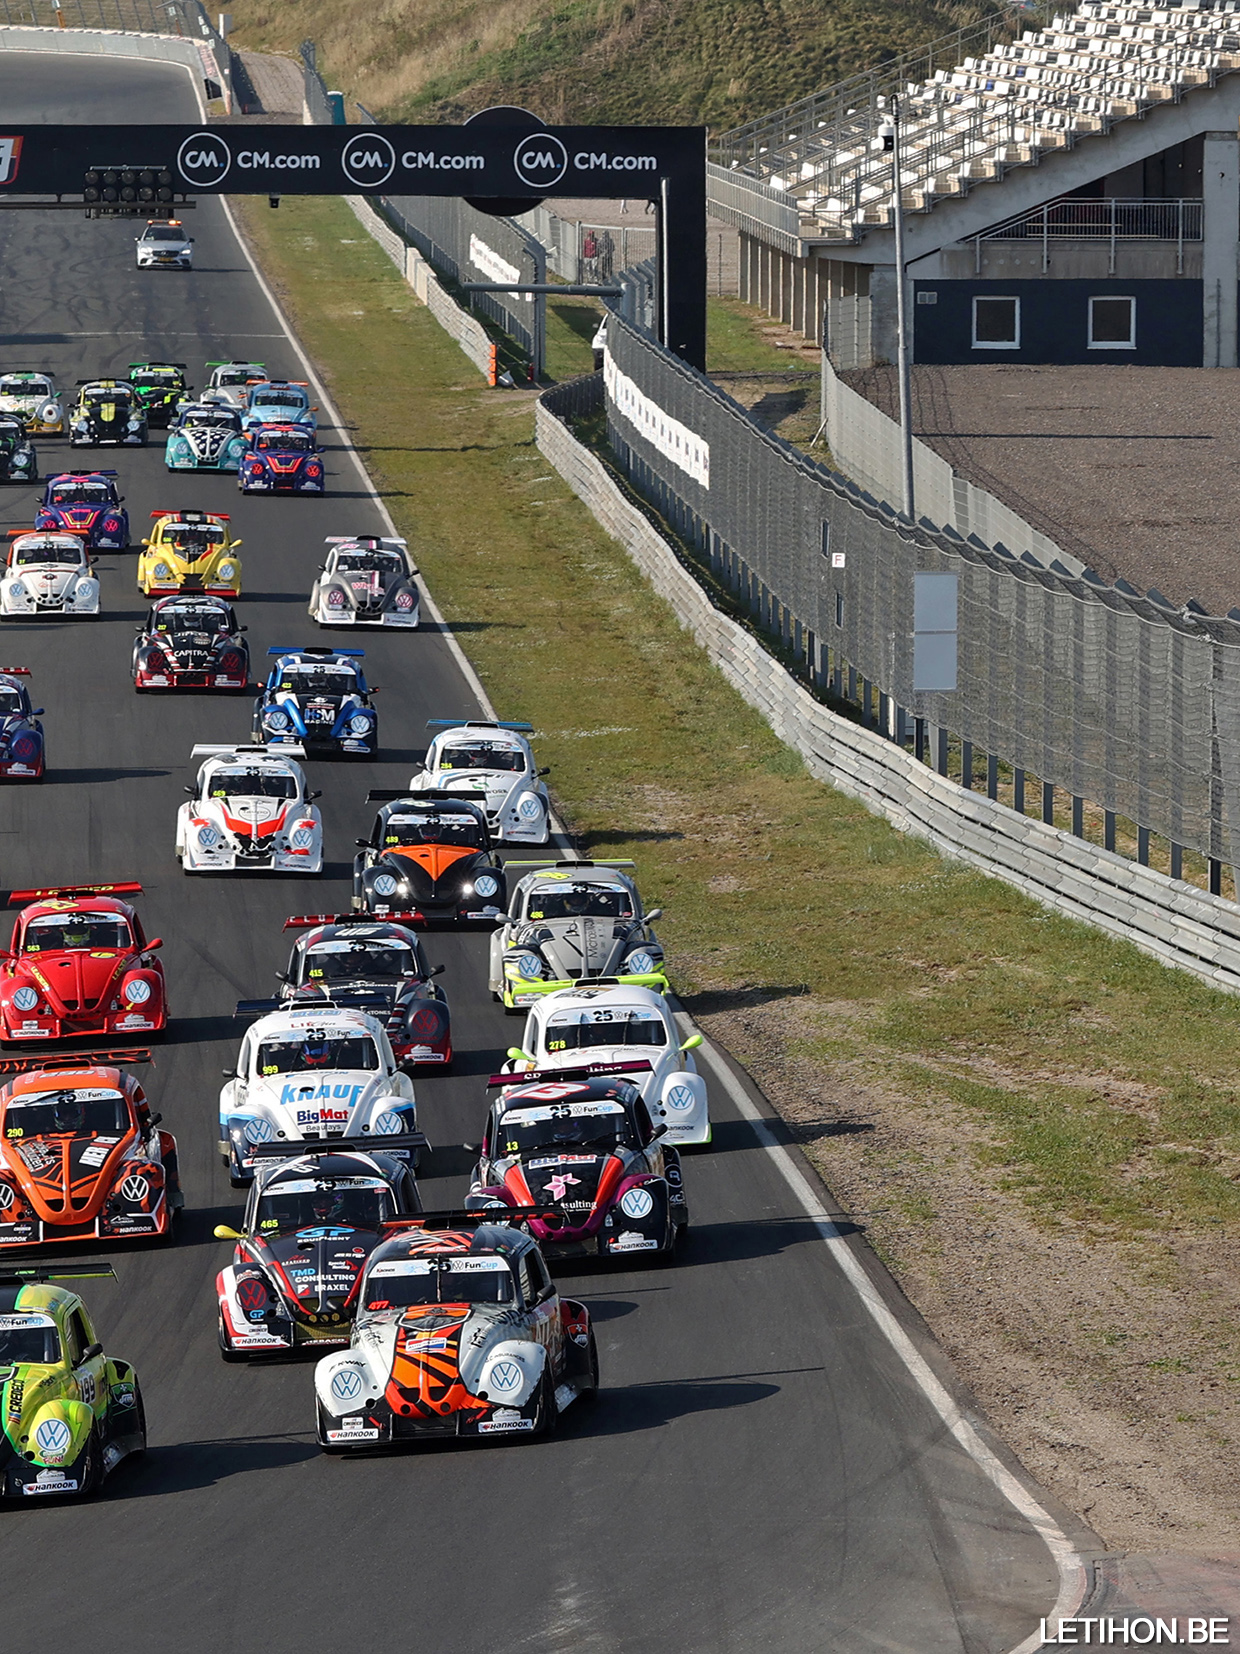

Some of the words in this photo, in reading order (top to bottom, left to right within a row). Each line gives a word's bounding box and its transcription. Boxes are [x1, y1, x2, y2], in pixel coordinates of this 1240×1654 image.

[237, 151, 321, 169] CM.com
[401, 151, 485, 169] CM.com
[573, 152, 657, 170] CM.com
[174, 649, 209, 657] CAPITRA
[593, 1010, 614, 1022] 25
[306, 1029, 326, 1041] 25
[549, 1041, 566, 1050] 278
[262, 1065, 278, 1074] 999
[280, 1084, 364, 1107] KNAUF
[297, 1109, 349, 1123] BigMat
[550, 1105, 572, 1119] 25
[7, 1128, 24, 1137] 290
[506, 1142, 519, 1151] 13
[261, 1219, 278, 1229] 465
[464, 1261, 498, 1270] FunCup
[290, 1268, 315, 1277] TMD
[295, 1274, 356, 1283] CONSULTING
[369, 1300, 389, 1310] 477
[11, 1317, 45, 1327] FunCup
[489, 1421, 530, 1430] HANKOOK
[336, 1430, 375, 1438] HANKOOK
[34, 1481, 75, 1490] HANKOOK
